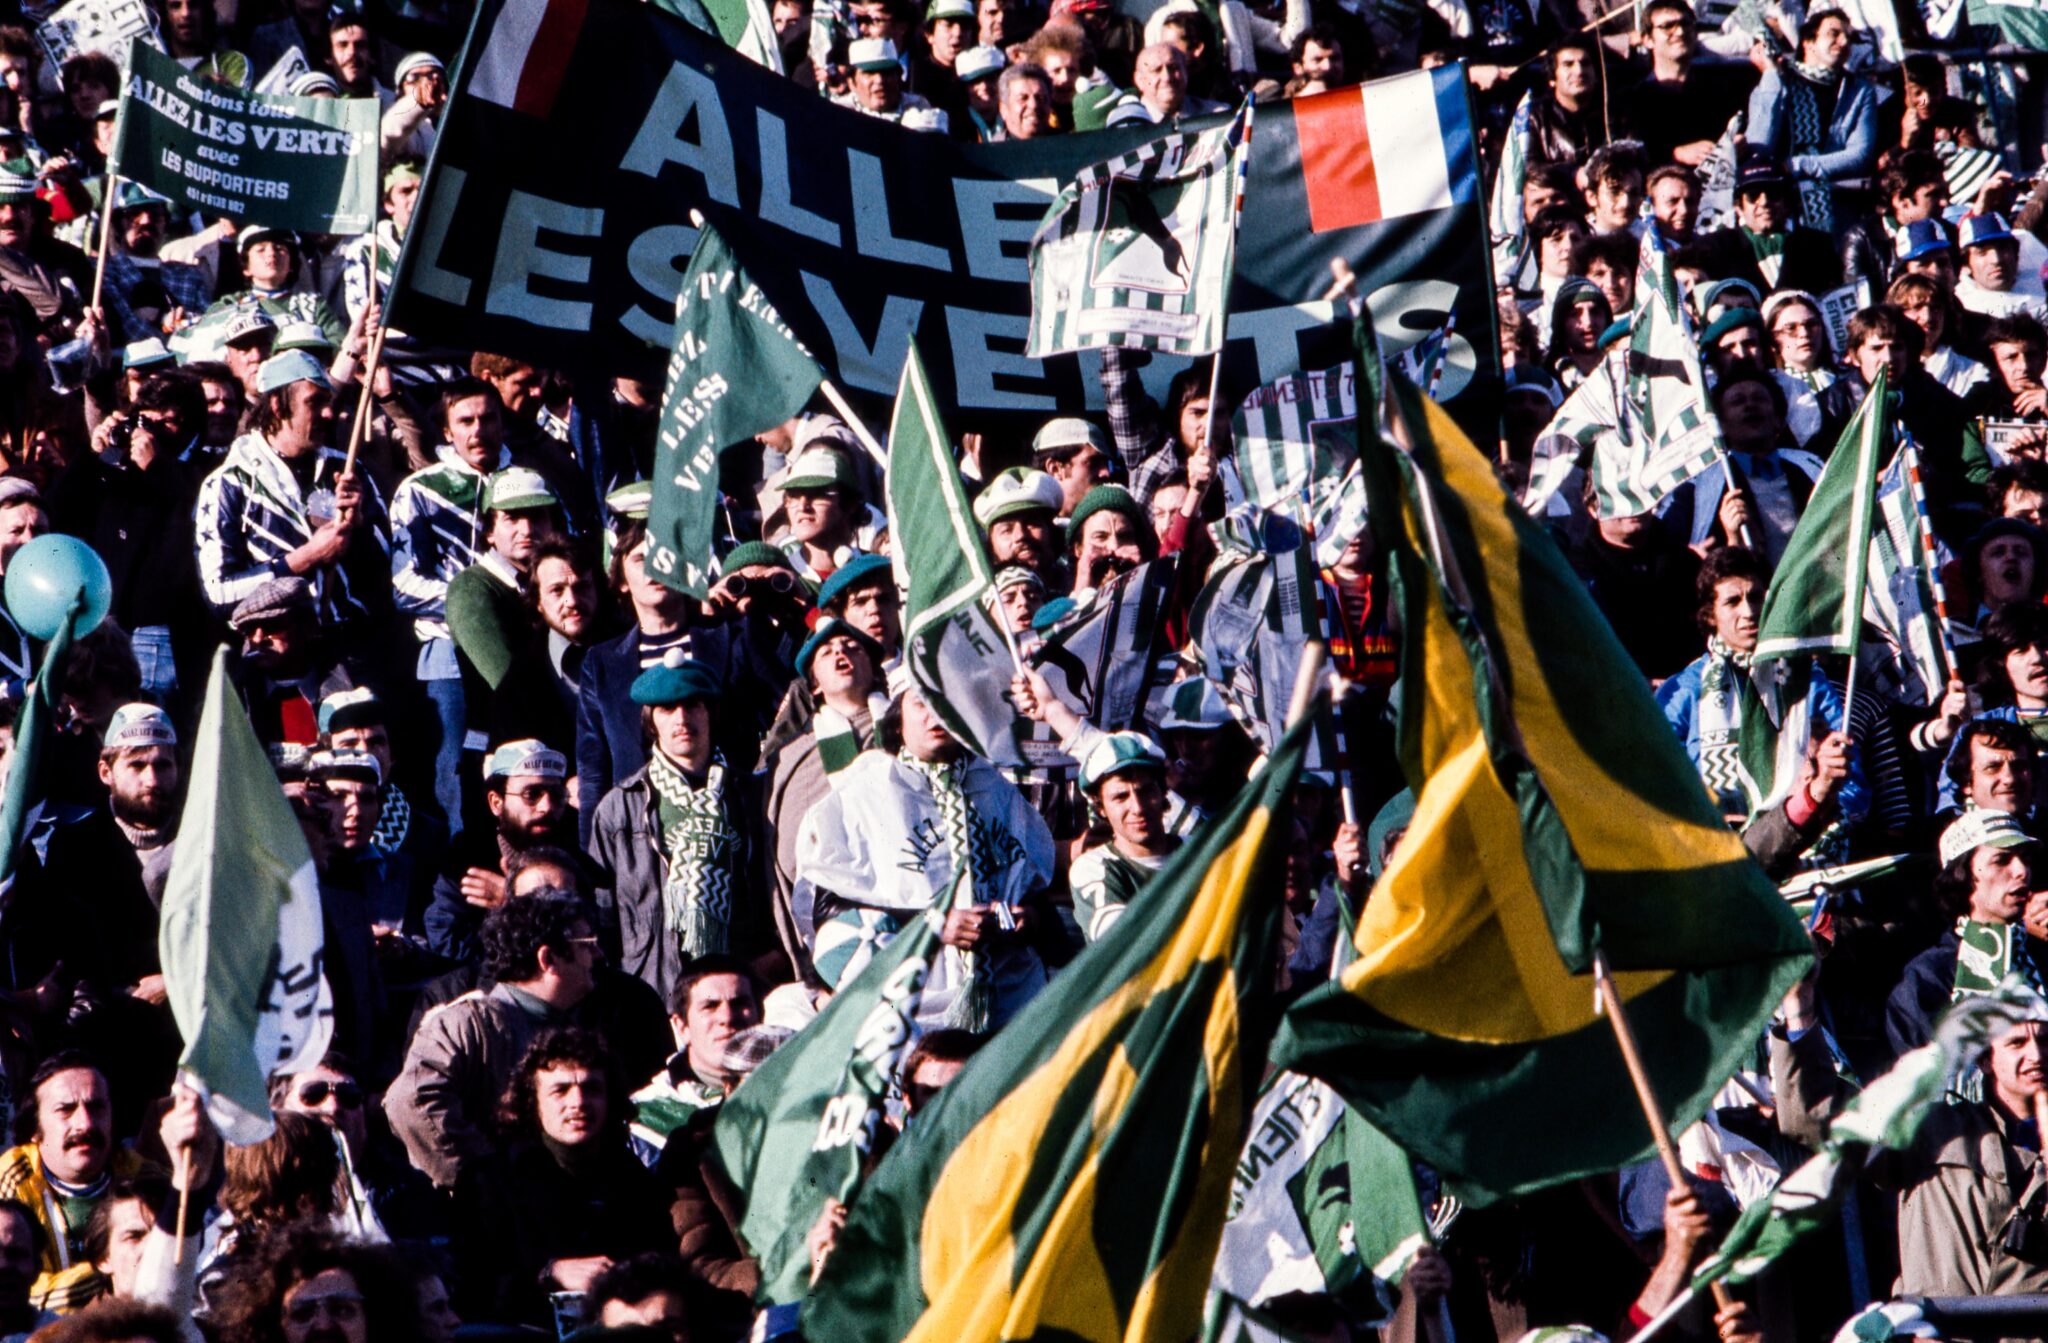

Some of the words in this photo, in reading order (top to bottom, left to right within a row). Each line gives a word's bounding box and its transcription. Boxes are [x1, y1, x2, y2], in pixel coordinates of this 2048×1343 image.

[176, 75, 244, 113] chantons
[249, 98, 297, 121] tous
[192, 110, 246, 146] LES
[162, 148, 183, 174] LES
[184, 160, 290, 200] SUPPORTERS
[197, 145, 241, 167] avec
[619, 60, 1059, 284] ALLE
[801, 269, 1477, 410] VETS
[897, 816, 946, 874] ALLEZ
